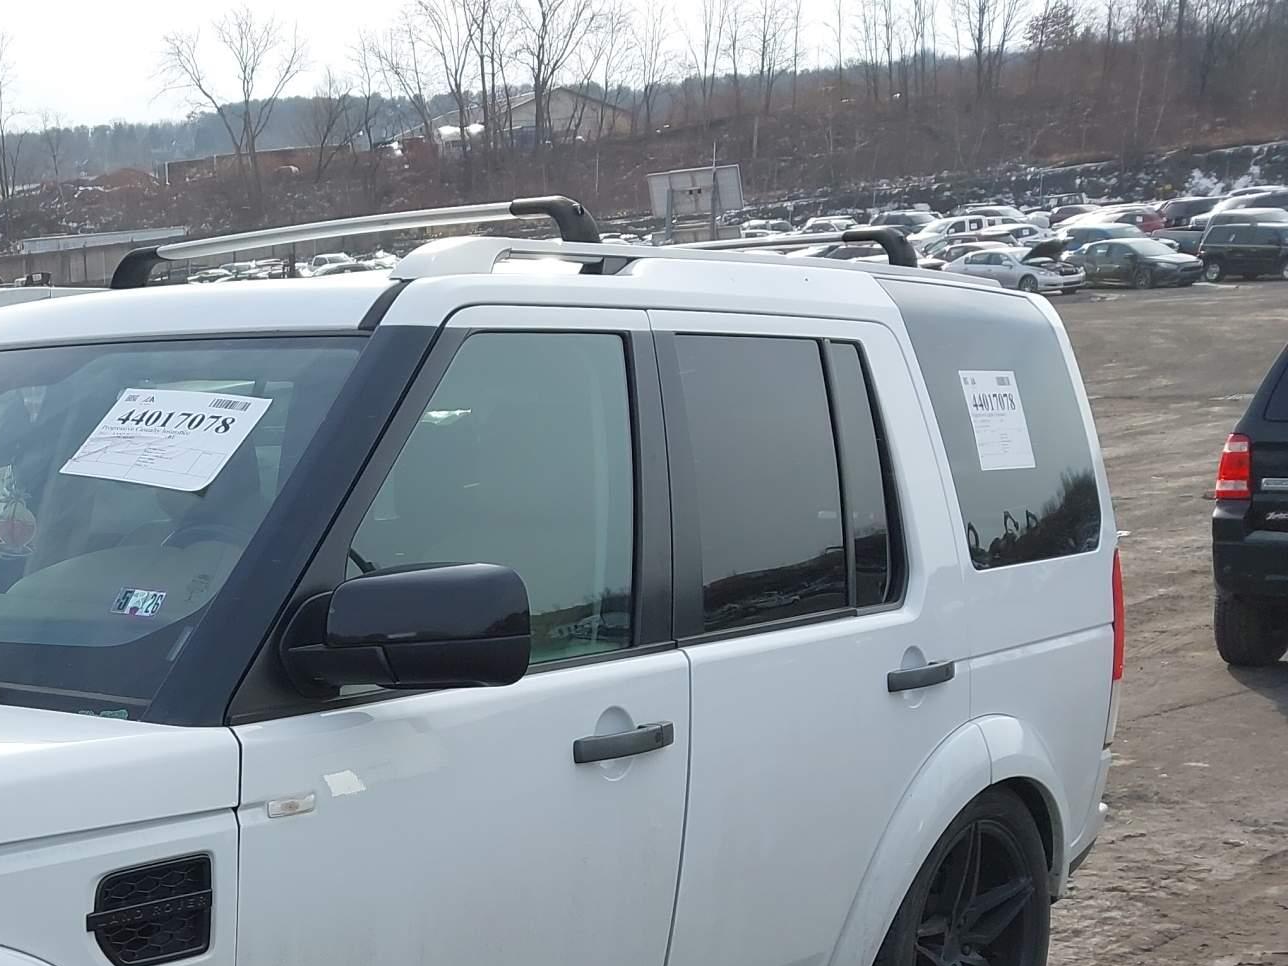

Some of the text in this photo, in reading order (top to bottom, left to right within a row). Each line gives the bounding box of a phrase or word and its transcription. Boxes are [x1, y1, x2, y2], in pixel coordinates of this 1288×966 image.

[972, 392, 1016, 411] 44017078
[116, 409, 236, 434] 44017078
[144, 593, 164, 614] 26
